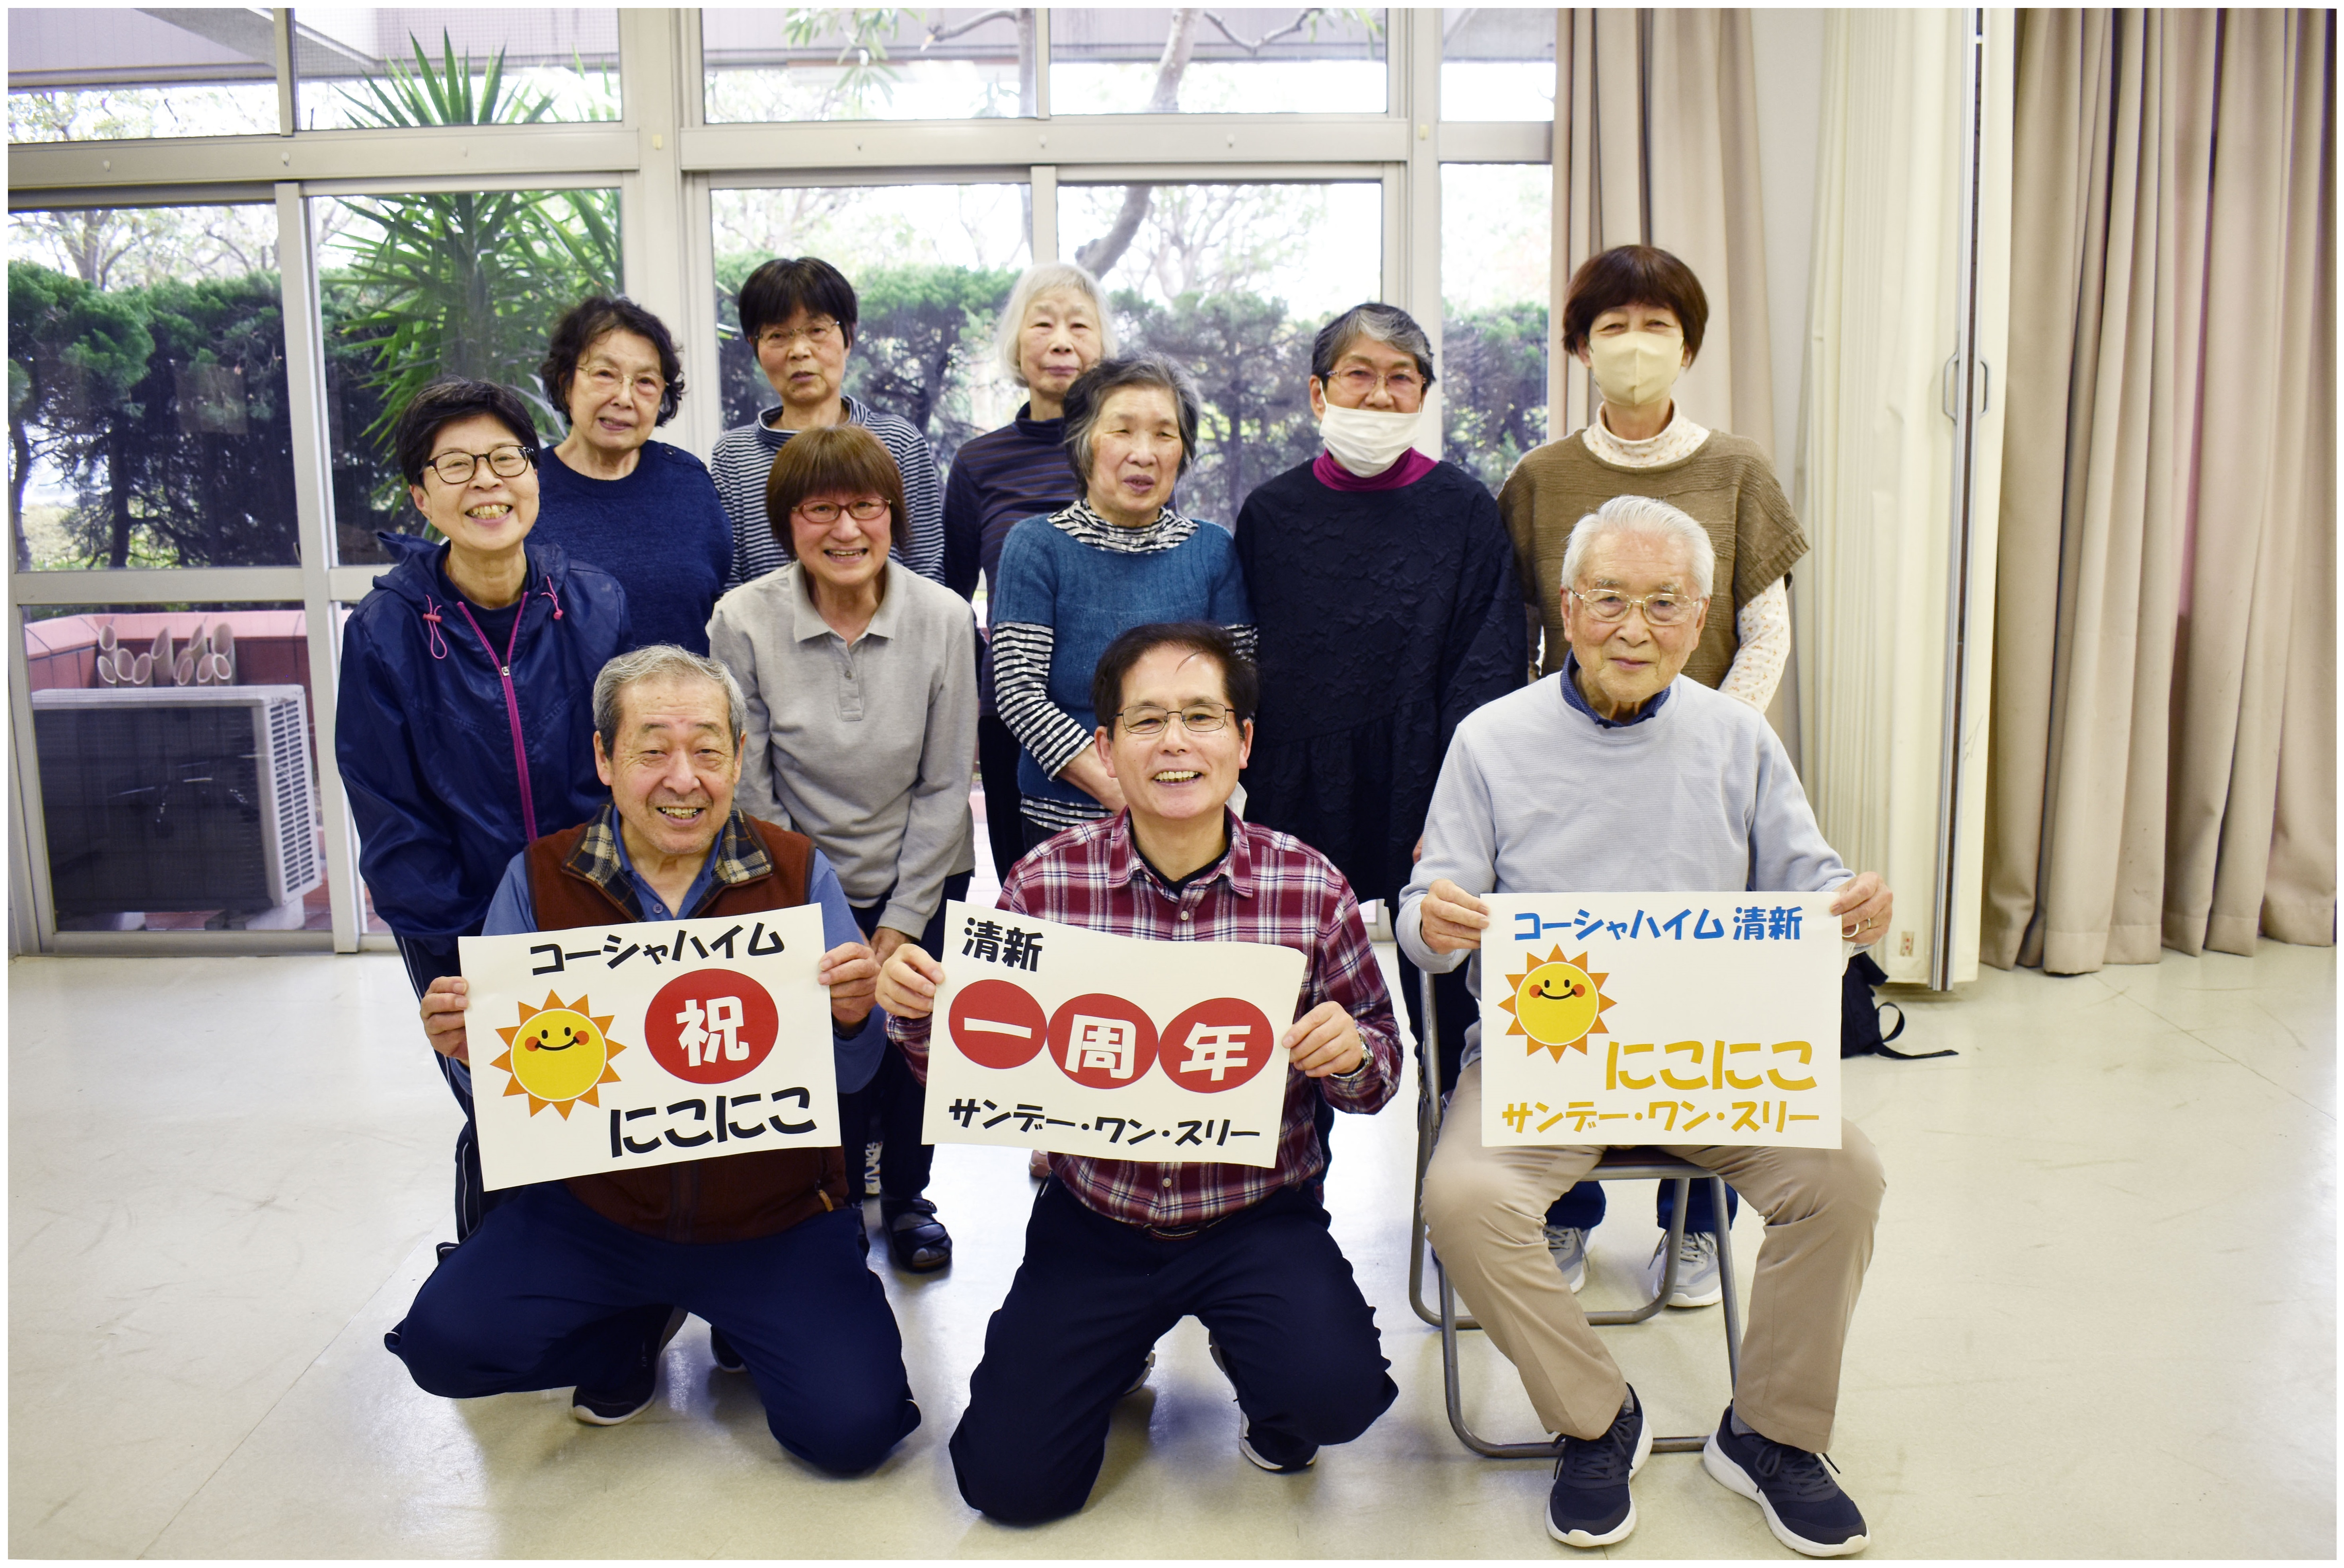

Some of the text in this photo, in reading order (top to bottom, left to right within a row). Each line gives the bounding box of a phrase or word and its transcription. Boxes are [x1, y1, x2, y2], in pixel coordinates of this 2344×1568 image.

[530, 922, 785, 975] コーシャハイム
[962, 918, 1043, 971] 清新
[676, 996, 749, 1066] 祝
[1606, 1040, 1816, 1090] にこにこ
[610, 1087, 817, 1158] にこにこ
